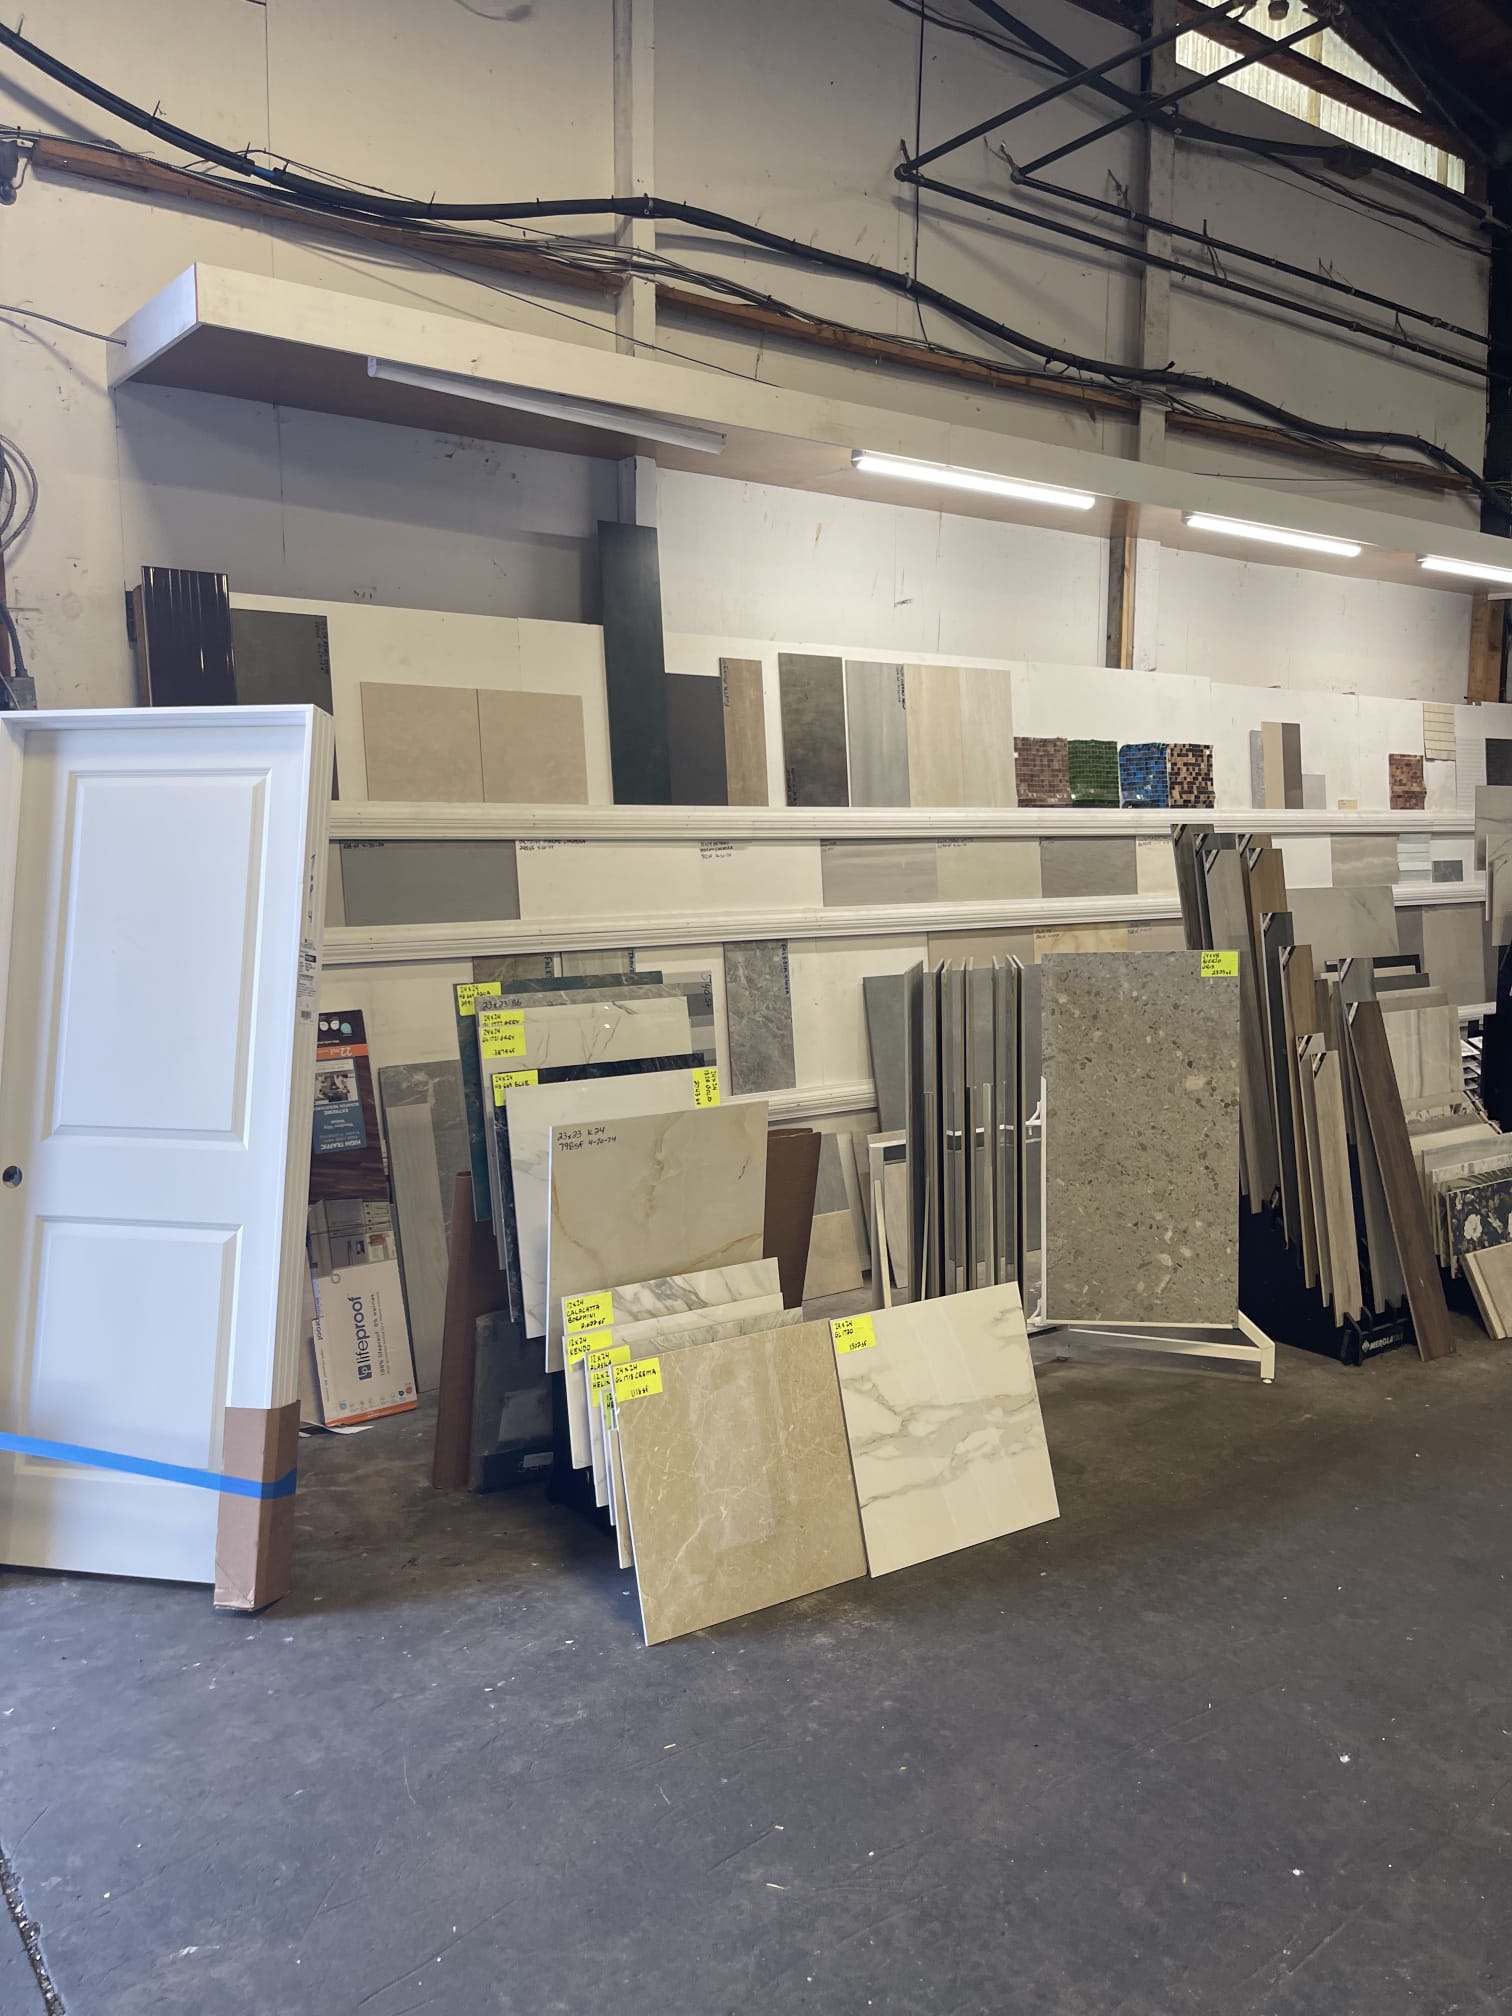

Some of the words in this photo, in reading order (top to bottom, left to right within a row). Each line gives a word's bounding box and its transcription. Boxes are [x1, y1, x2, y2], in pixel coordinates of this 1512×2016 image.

[566, 1304, 600, 1317] CALACATTA
[348, 1296, 370, 1364] lifeproof
[593, 1371, 610, 1380] 12x2
[616, 1364, 638, 1375] 24x24
[635, 1368, 657, 1380] CREMA
